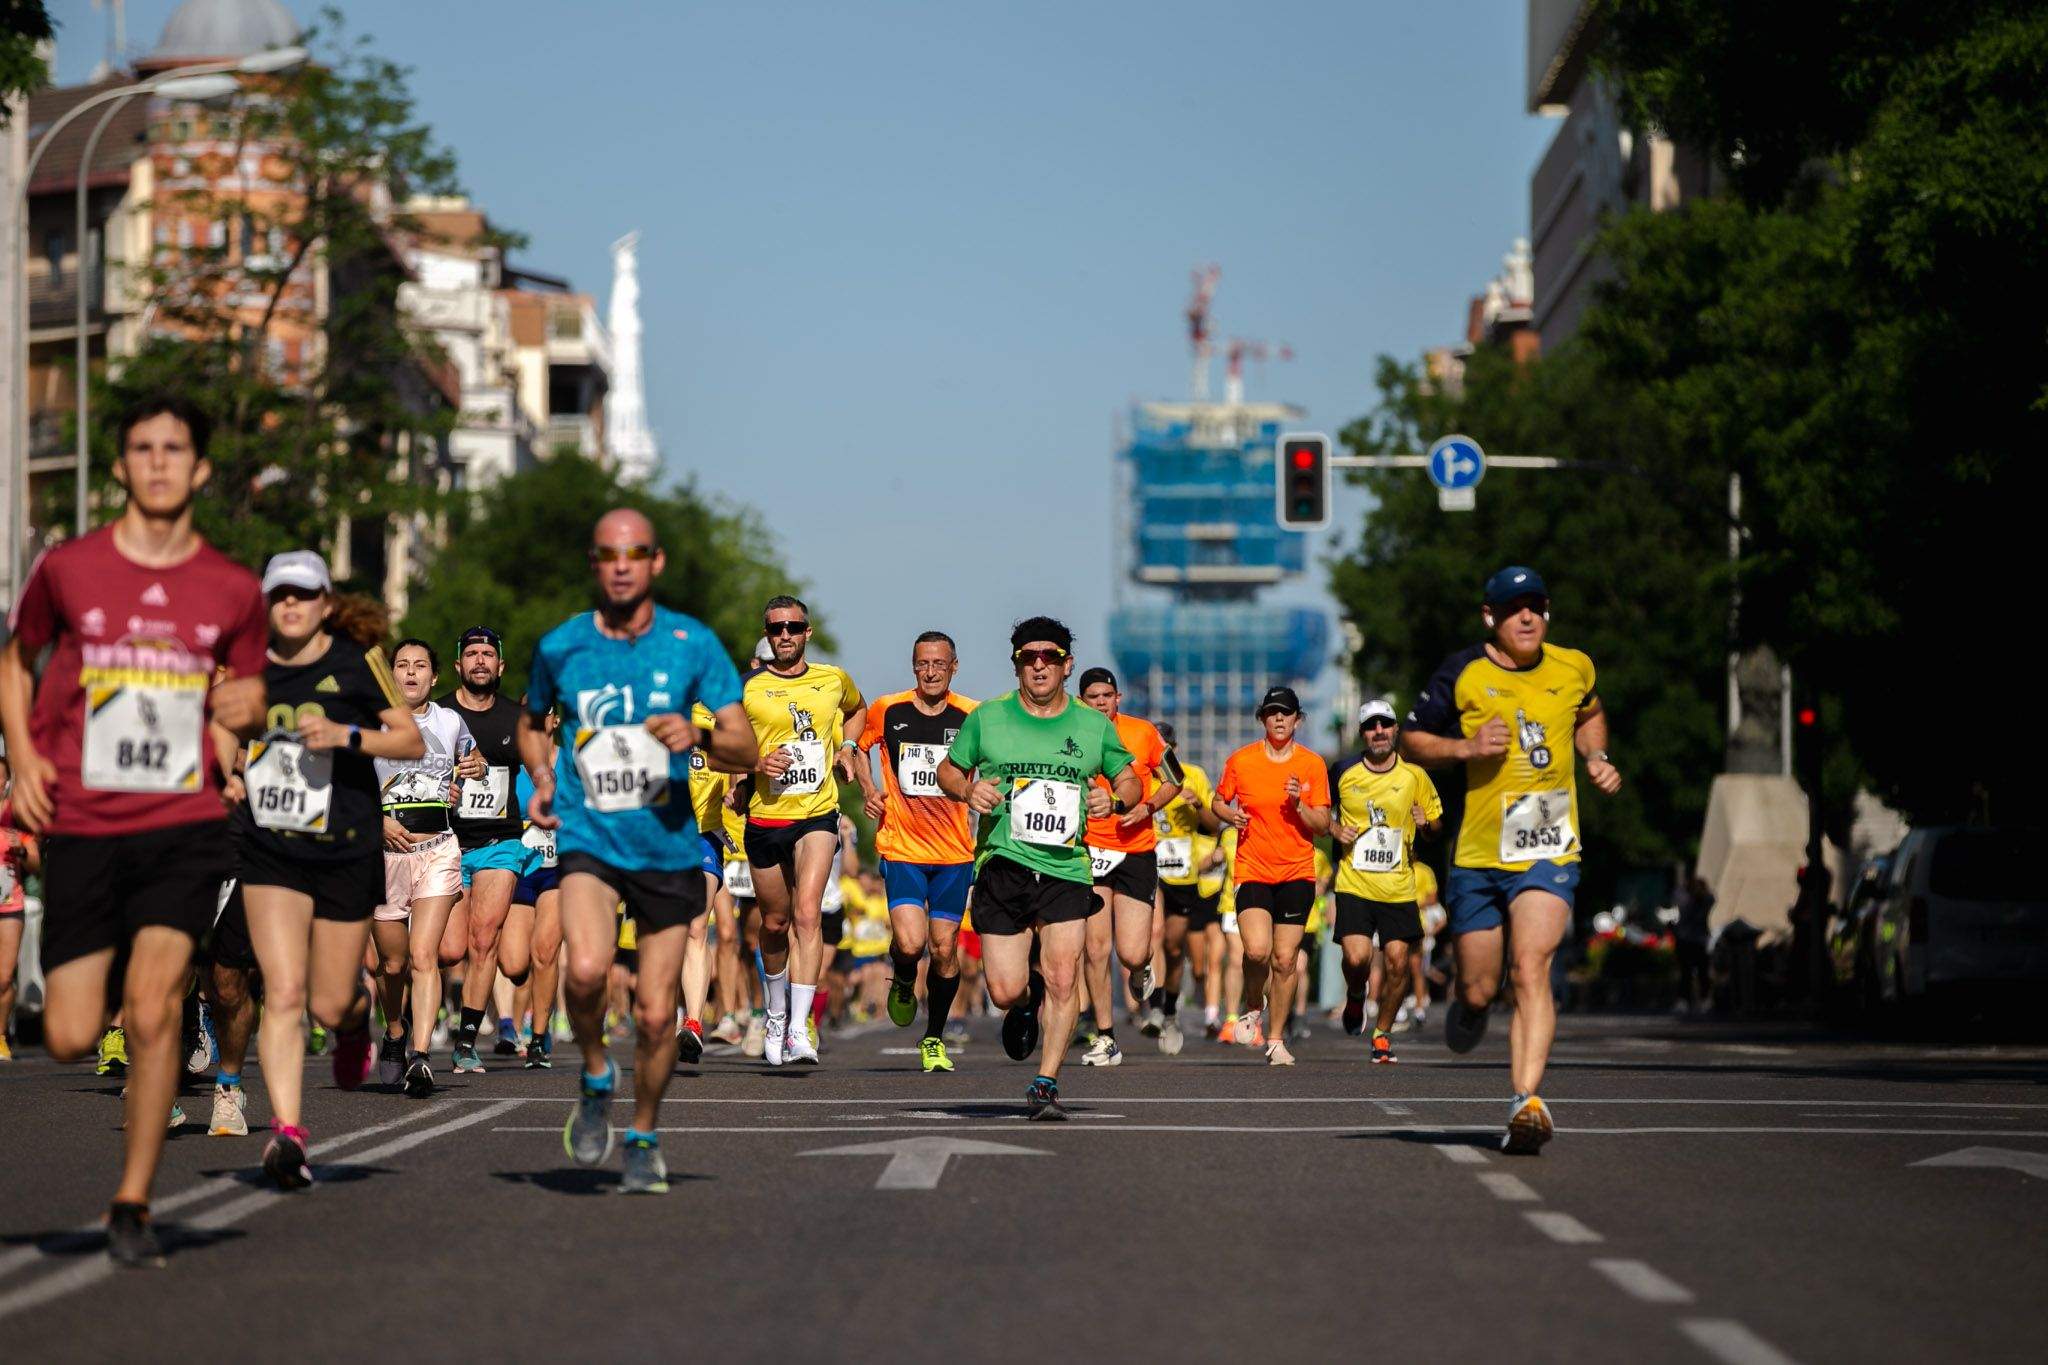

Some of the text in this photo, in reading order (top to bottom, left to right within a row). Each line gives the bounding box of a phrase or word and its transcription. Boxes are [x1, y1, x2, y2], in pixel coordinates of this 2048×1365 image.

[117, 740, 168, 769] 842
[692, 757, 703, 767] 13
[1533, 750, 1549, 764] 13
[594, 769, 649, 793] 1504
[780, 768, 817, 785] 3846
[258, 786, 306, 813] 1501
[470, 794, 494, 808] 722
[1025, 812, 1066, 834] 1804
[1364, 849, 1393, 862] 1889
